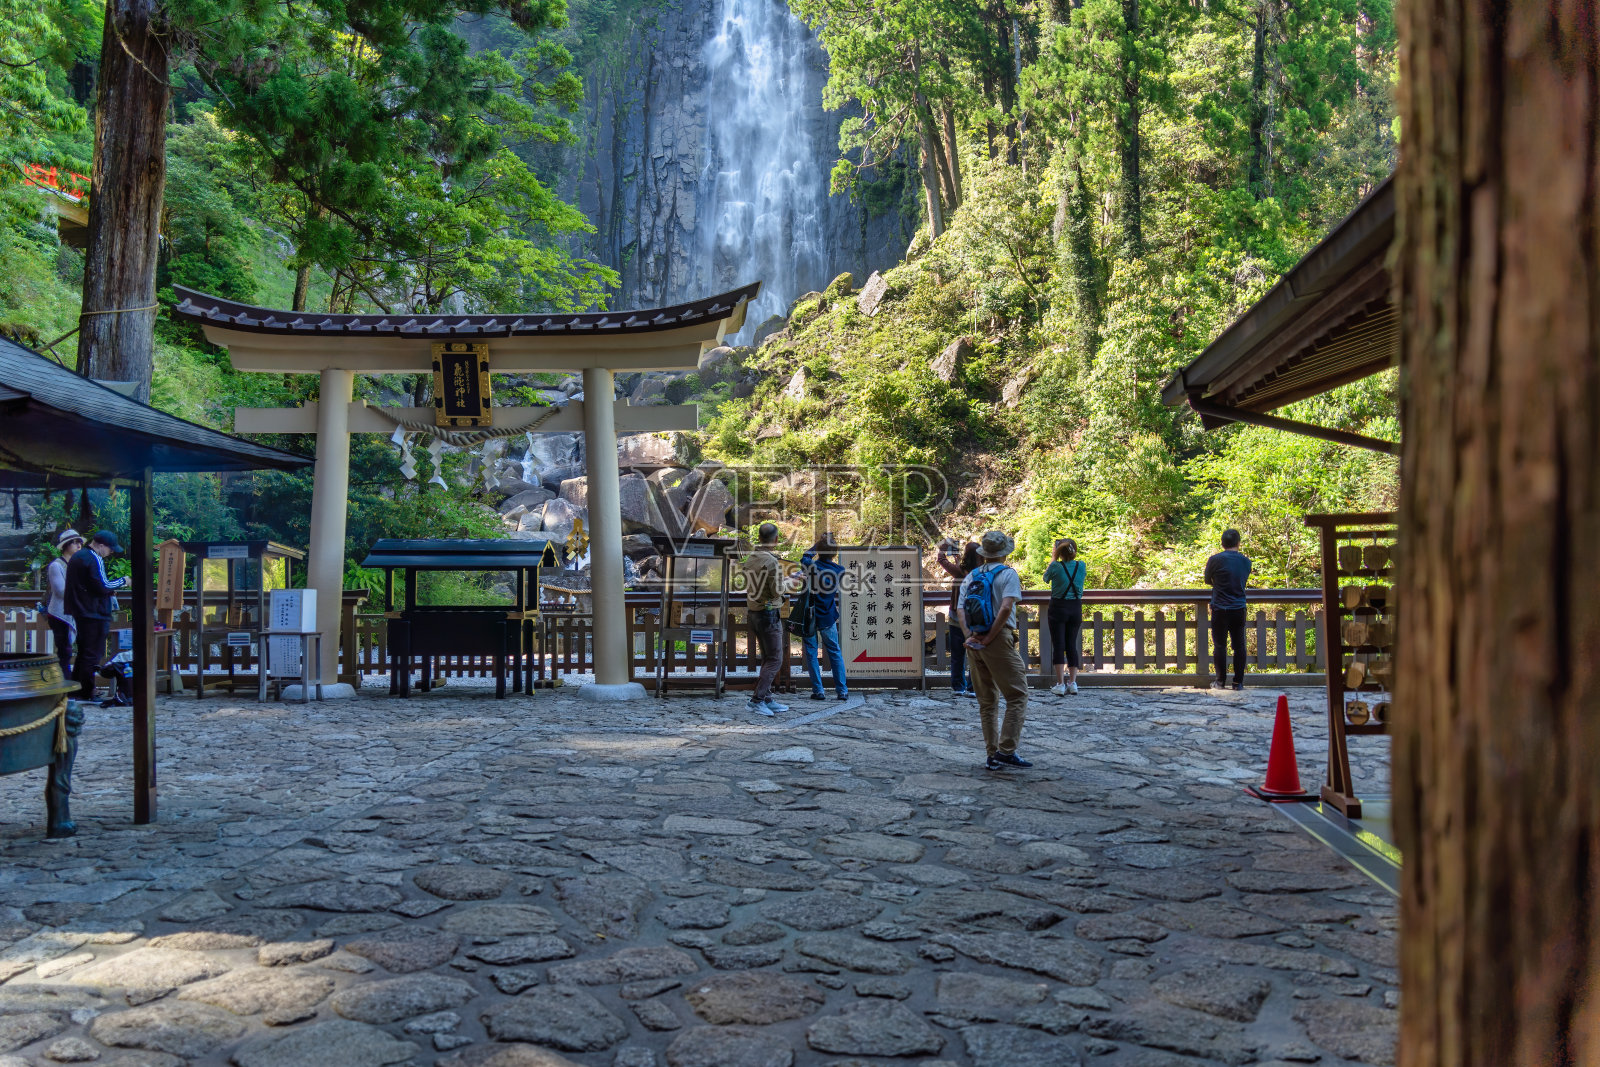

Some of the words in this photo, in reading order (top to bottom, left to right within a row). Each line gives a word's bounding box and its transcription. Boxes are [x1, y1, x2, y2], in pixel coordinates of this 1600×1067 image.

[884, 560, 895, 640] 延命長寿の水
